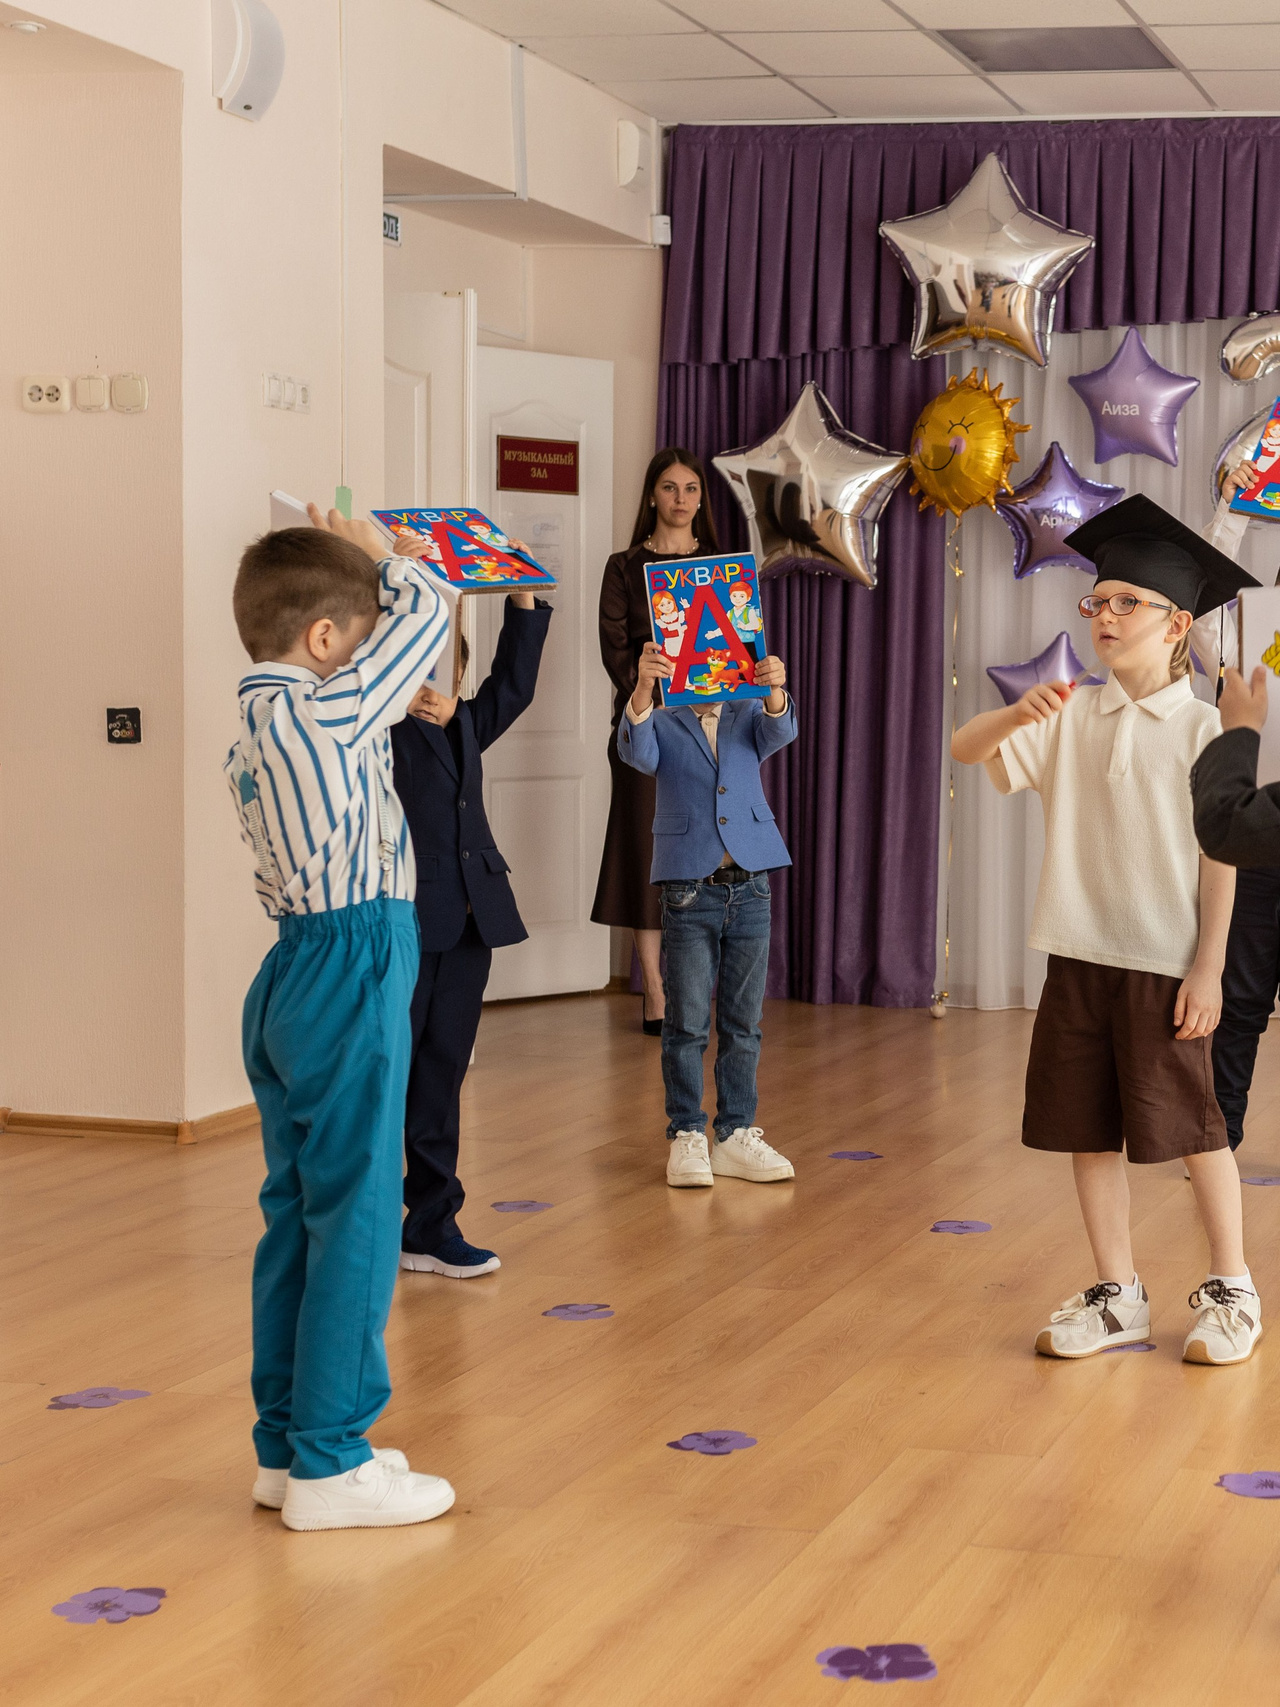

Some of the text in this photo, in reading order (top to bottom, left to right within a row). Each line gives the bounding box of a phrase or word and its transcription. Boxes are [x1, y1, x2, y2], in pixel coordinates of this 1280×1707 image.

[1101, 400, 1140, 416] Аиза
[504, 450, 574, 465] МУЗЫКАЛЬНЫЙ
[530, 467, 548, 478] ЗАЛ
[376, 511, 485, 524] БУКВАРЬ
[430, 521, 548, 581] А
[650, 562, 756, 590] БУКВАРЬ
[669, 585, 760, 694] А
